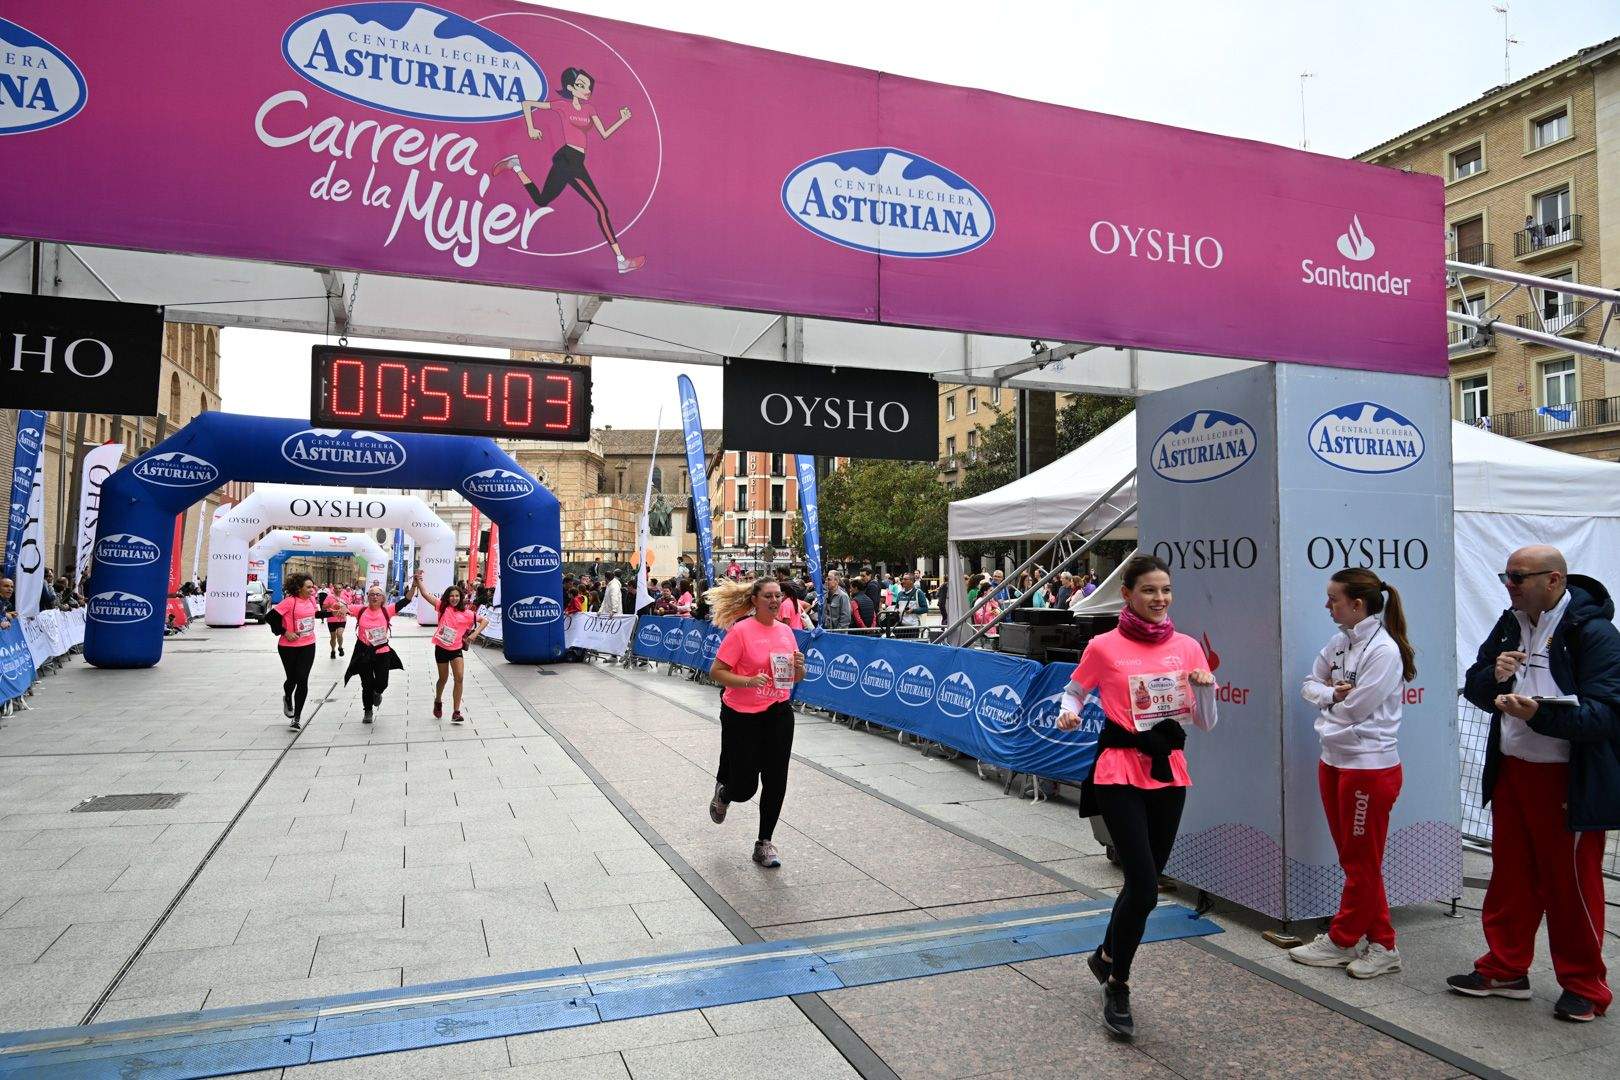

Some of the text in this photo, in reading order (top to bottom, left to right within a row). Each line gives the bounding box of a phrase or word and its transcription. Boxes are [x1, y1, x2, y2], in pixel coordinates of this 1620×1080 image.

[348, 31, 521, 71] CENTRAL LECHERA
[303, 28, 527, 103] ASTURIANA
[255, 90, 478, 176] Carrera
[309, 160, 391, 209] de la
[834, 178, 973, 206] CENTRAL LECHERA
[383, 168, 554, 268] Mujer
[799, 177, 980, 237] ASTURIANA
[1089, 220, 1224, 269] OYSHO
[1301, 259, 1411, 296] Santander
[760, 393, 910, 433] OYSHO
[1171, 428, 1244, 447] CENTRAL LECHERA
[1317, 425, 1418, 458] ASTURIANA
[1335, 425, 1413, 437] CENTRAL LECHERA
[291, 439, 398, 465] ASTURIANA
[311, 439, 394, 450] CENTRAL LECHERA
[1157, 437, 1249, 470] ASTURIANA
[137, 462, 212, 480] ASTURIANA
[469, 480, 530, 492] ASTURIANA
[290, 498, 387, 519] OYSHO
[228, 516, 260, 525] OYSHO
[96, 544, 155, 560] ASTURIANA
[212, 553, 242, 561] OYSHO
[511, 556, 558, 567] ASTURIANA
[1153, 536, 1258, 570] OYSHO
[1307, 536, 1429, 570] OYSHO
[89, 601, 148, 617] ASTURIANA
[512, 607, 559, 618] ASTURIANA
[584, 616, 622, 634] OYSHO
[829, 665, 856, 682] ASTURIANA
[862, 671, 891, 690] ASTURIANA
[897, 679, 932, 698] ASTURIANA
[1216, 682, 1250, 705] der
[1353, 789, 1370, 837] Joma
